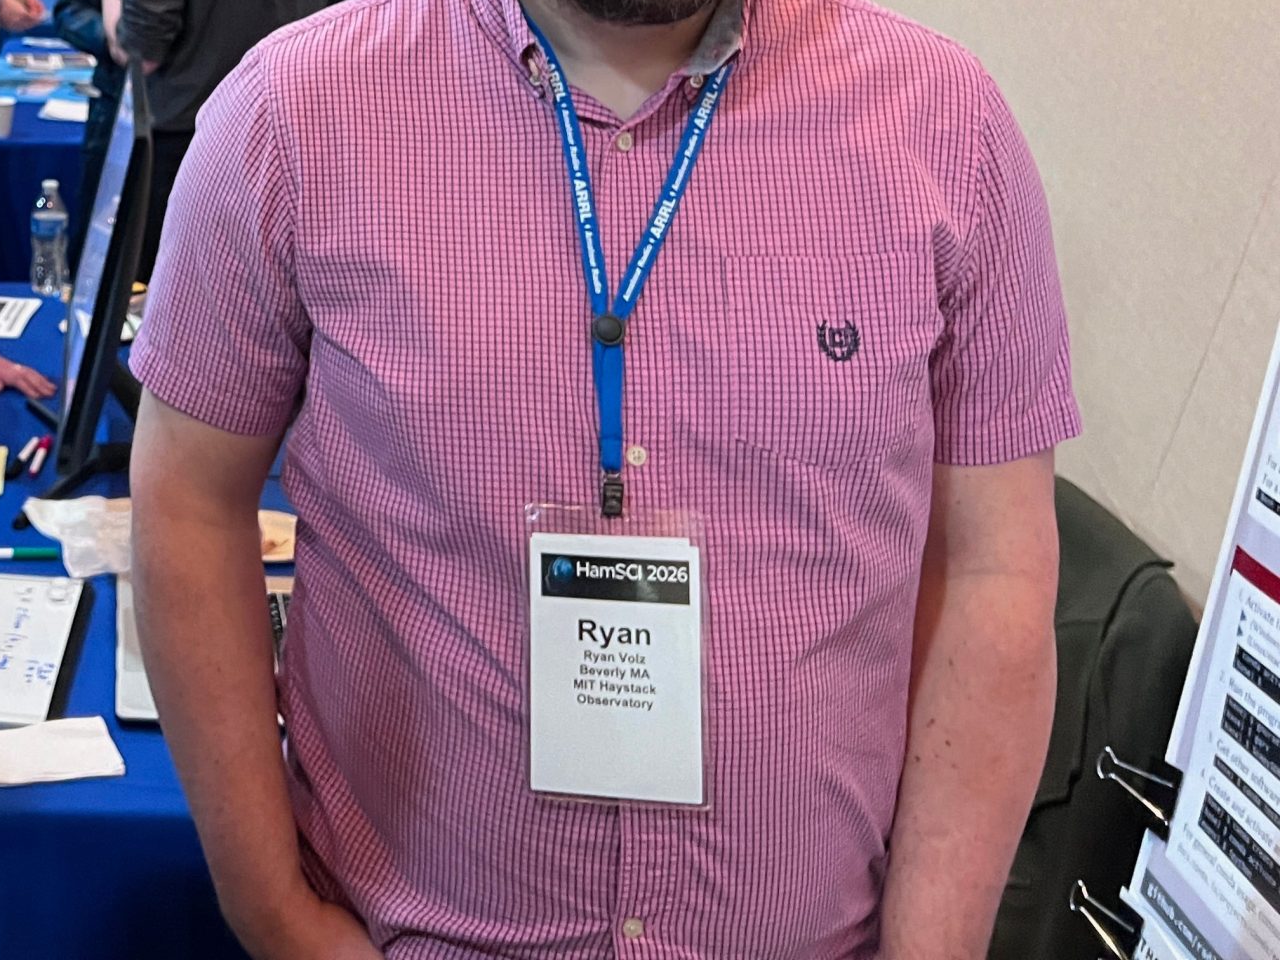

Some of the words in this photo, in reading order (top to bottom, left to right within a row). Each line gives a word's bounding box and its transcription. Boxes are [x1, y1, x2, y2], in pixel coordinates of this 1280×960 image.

[650, 198, 676, 239] ARRL
[694, 90, 719, 130] ARRL
[573, 178, 592, 223] ARRL
[576, 561, 643, 581] HamSCI
[646, 565, 688, 583] 2026
[578, 619, 651, 649] Ryan
[583, 650, 615, 664] Ryan
[619, 652, 646, 665] Volz
[579, 665, 626, 680] Beverly
[630, 668, 650, 679] MA
[573, 679, 595, 691] MIT
[599, 680, 656, 695] Haystack
[577, 694, 654, 711] Observatory
